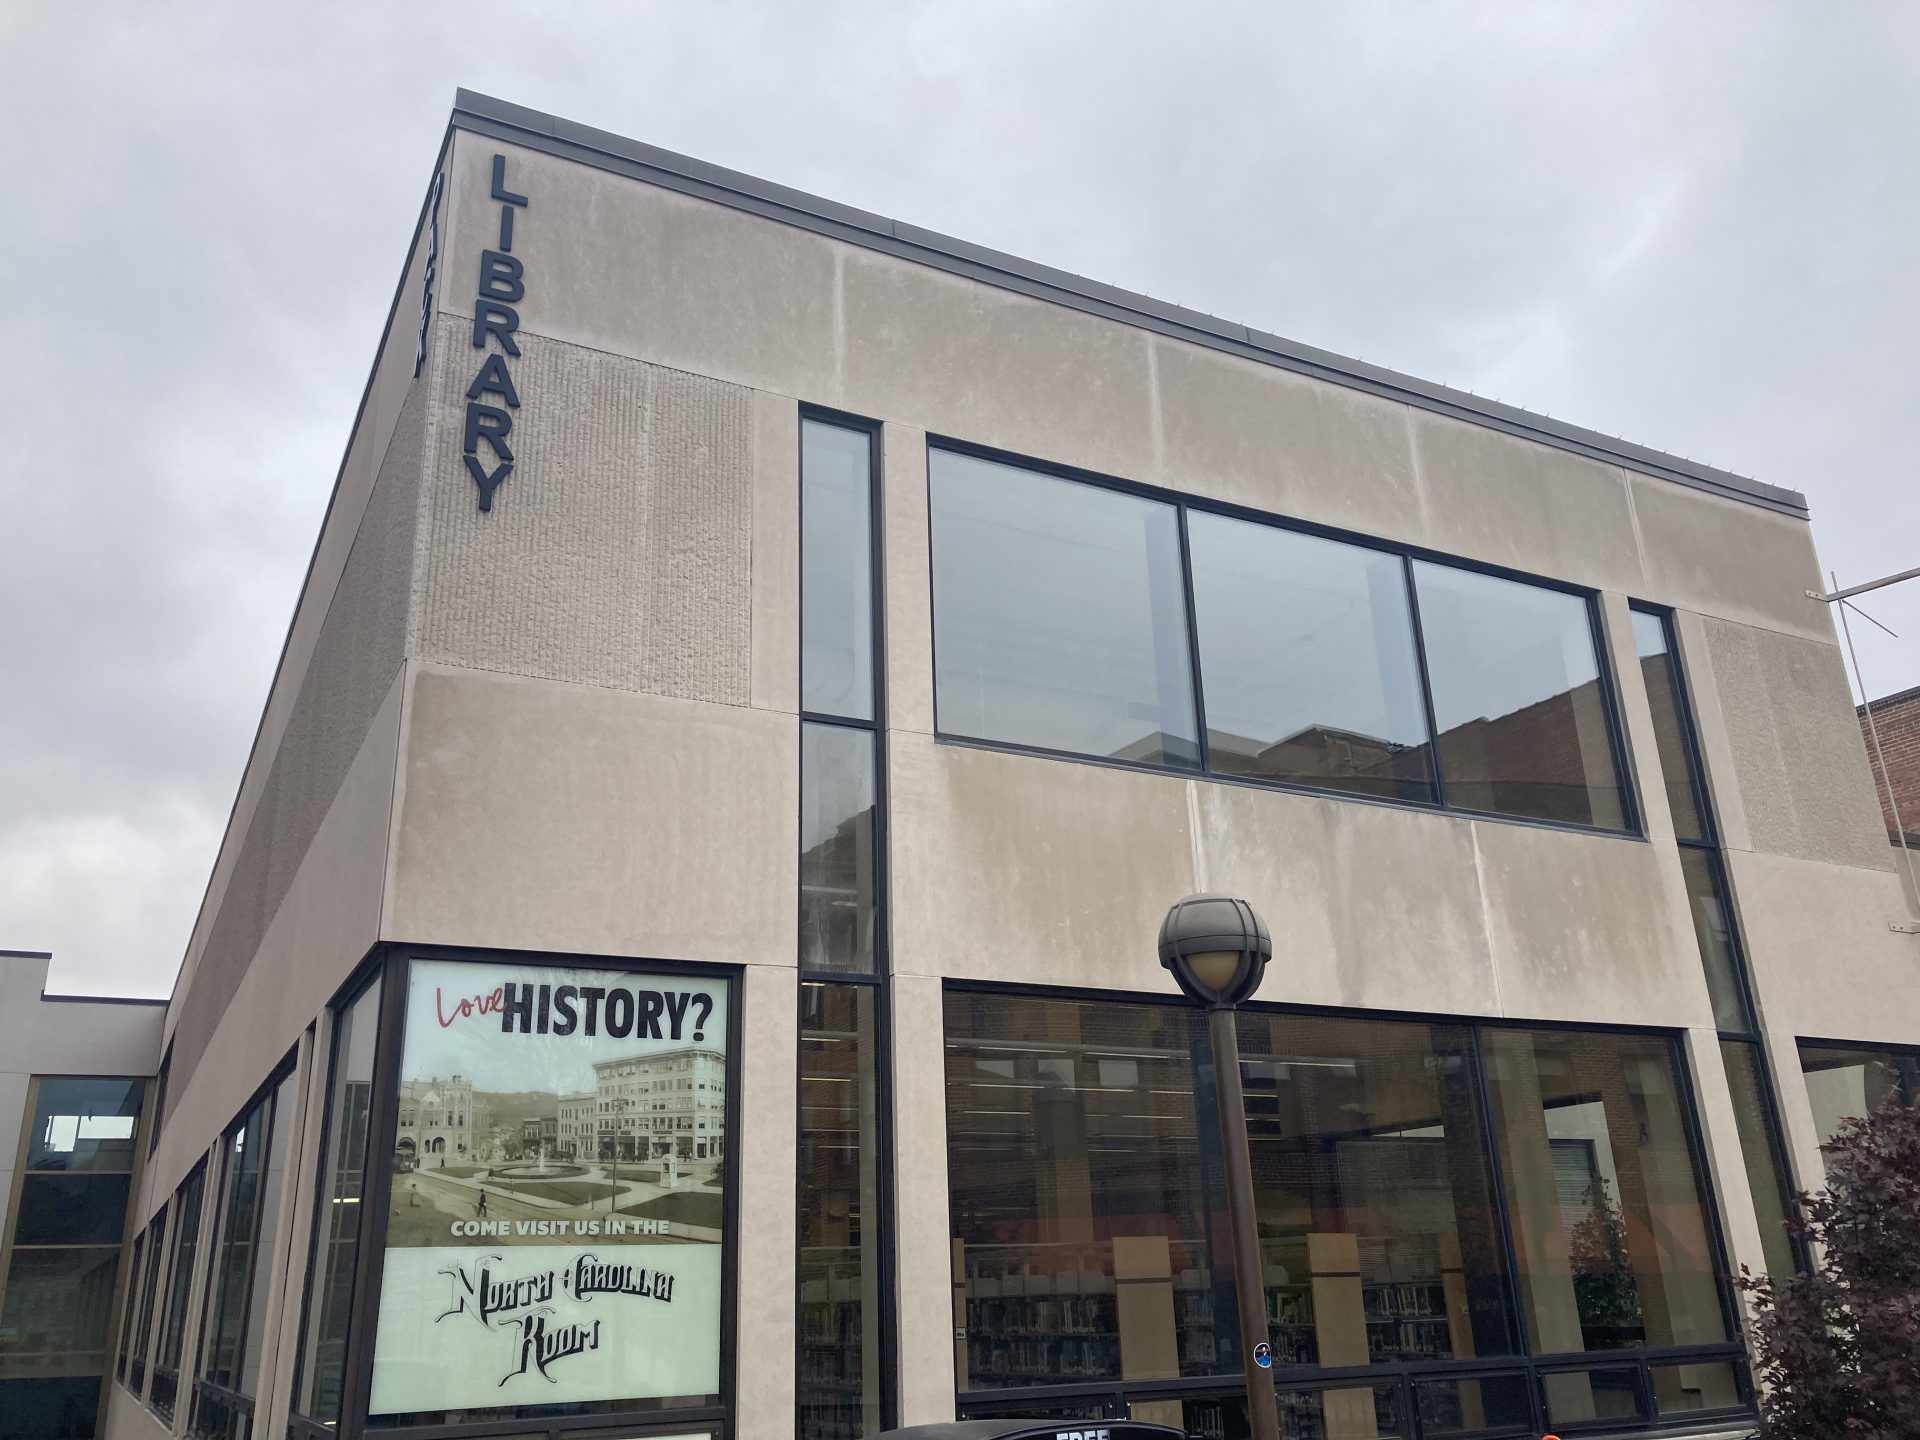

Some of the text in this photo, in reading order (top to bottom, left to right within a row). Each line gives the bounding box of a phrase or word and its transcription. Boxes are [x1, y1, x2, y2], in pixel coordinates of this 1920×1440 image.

[463, 154, 528, 511] LIBRARY
[436, 982, 714, 1042] Love HISTORY?
[450, 1219, 670, 1237] COME VISIT US IN THE
